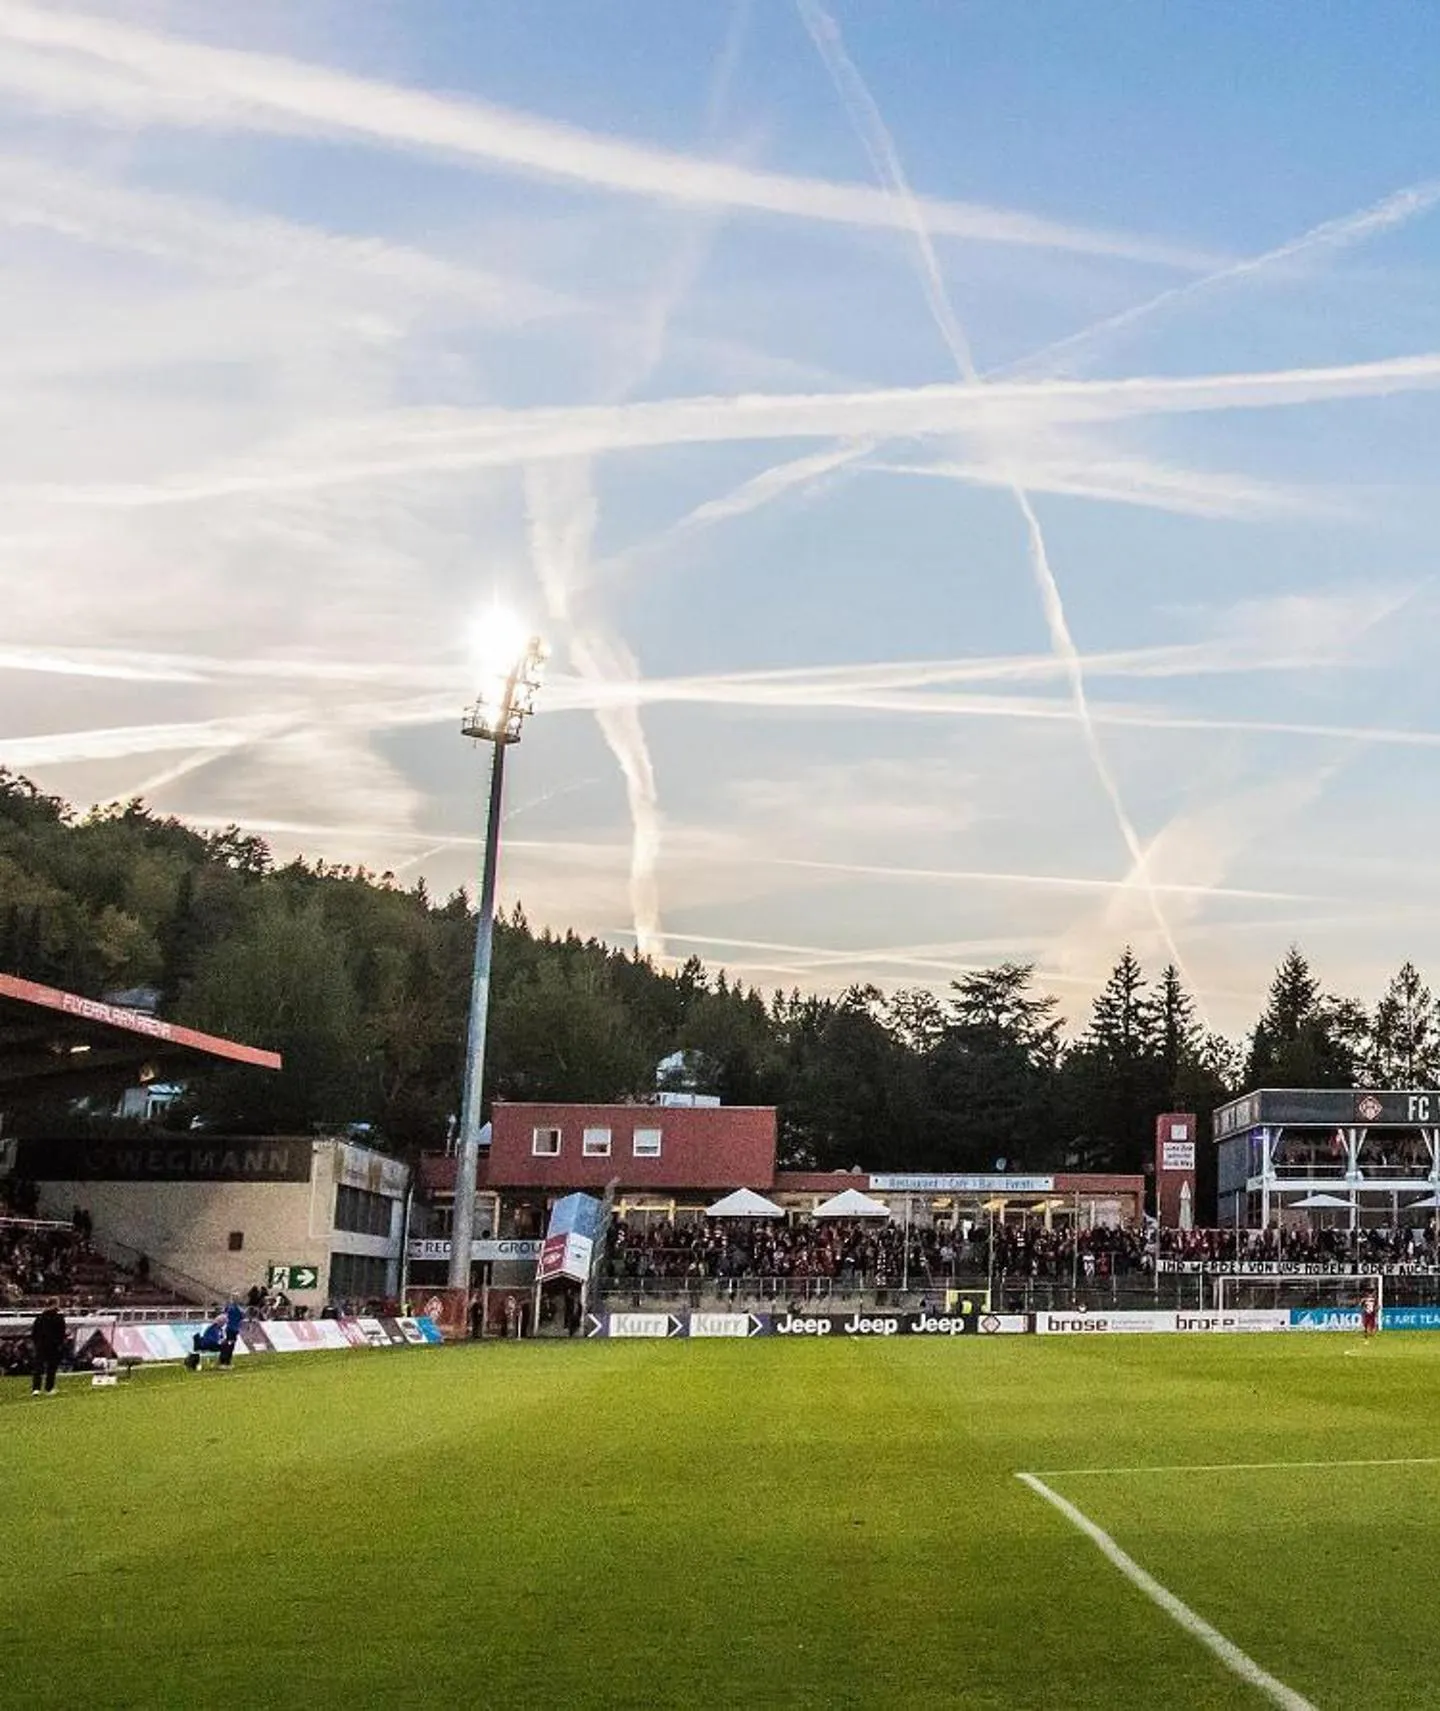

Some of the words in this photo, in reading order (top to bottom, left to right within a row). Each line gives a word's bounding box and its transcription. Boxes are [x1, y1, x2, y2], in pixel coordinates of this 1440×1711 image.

[1408, 1096, 1430, 1121] FC
[499, 1242, 541, 1253] GROU
[615, 1316, 661, 1333] Kurr
[777, 1314, 831, 1335] Jeep
[844, 1314, 898, 1335] Jeep
[911, 1313, 965, 1335] Jeep
[1048, 1315, 1108, 1332] brose
[1321, 1312, 1362, 1327] JAKO
